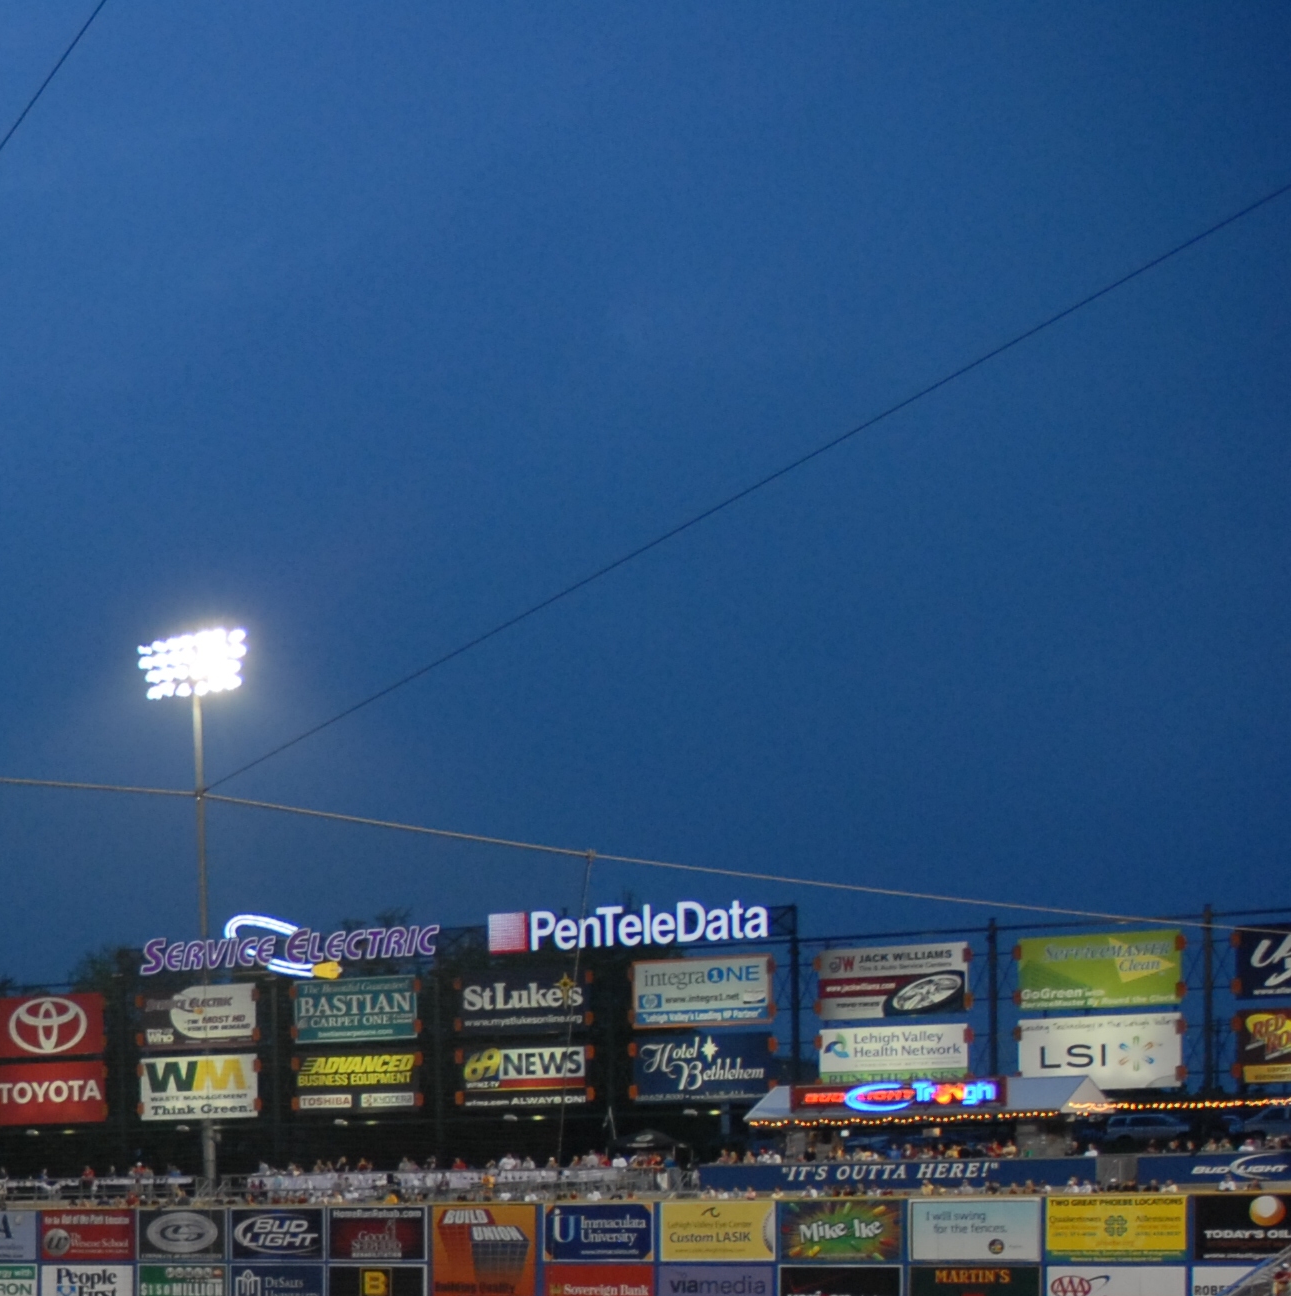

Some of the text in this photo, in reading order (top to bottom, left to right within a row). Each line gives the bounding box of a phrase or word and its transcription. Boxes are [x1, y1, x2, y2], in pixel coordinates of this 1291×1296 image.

[530, 900, 768, 951] PenTeleData
[140, 925, 439, 976] SERVICE ELECTRIC
[859, 950, 952, 963] JACK WILLIAMS
[1118, 959, 1161, 972] Clean
[299, 992, 411, 1016] BASTIAN
[311, 1015, 390, 1028] CARPET ONE
[854, 1030, 943, 1046] Lehigh Valley
[640, 1036, 700, 1073] Hotel
[854, 1044, 961, 1057] Health Network
[1040, 1044, 1106, 1068] LSI
[312, 1055, 414, 1073] ADVANCED
[464, 1047, 581, 1081] 69 NEWS
[145, 1058, 246, 1092] WM
[298, 1072, 411, 1086] BUSINESS EQUIPMENT
[667, 1057, 764, 1090] Bethlehem
[301, 1097, 351, 1107] TOSHIBA
[511, 1096, 561, 1105] ALWAYS
[565, 1095, 586, 1104] ON!
[151, 1102, 252, 1116] Think Green.
[837, 1164, 906, 1180] OUTTA
[1192, 1163, 1289, 1176] BUD LIGHT
[1050, 1199, 1069, 1207] TWO
[1070, 1199, 1097, 1207] GREAT
[1135, 1198, 1183, 1206] LOCATIONS
[333, 1209, 421, 1219] HomeRunRehab.com
[441, 1209, 490, 1224] BUILD
[581, 1214, 646, 1229] Immaculata
[933, 1212, 952, 1220] will
[954, 1212, 986, 1223] swing
[253, 1219, 308, 1233] BUD
[473, 1226, 524, 1241] UNION
[800, 1217, 884, 1243] Mike Ike
[934, 1222, 1007, 1233] for the fences.
[244, 1232, 319, 1247] LIGHT
[581, 1229, 637, 1246] University
[670, 1231, 751, 1244] Custom LASIK
[1204, 1229, 1265, 1240] TODAY'S
[14, 1269, 33, 1277] with
[57, 1268, 117, 1288] People
[935, 1269, 1012, 1284] MARTIN'S
[364, 1271, 387, 1296] B
[620, 1284, 649, 1296] Bank
[670, 1275, 766, 1295] viamedia
